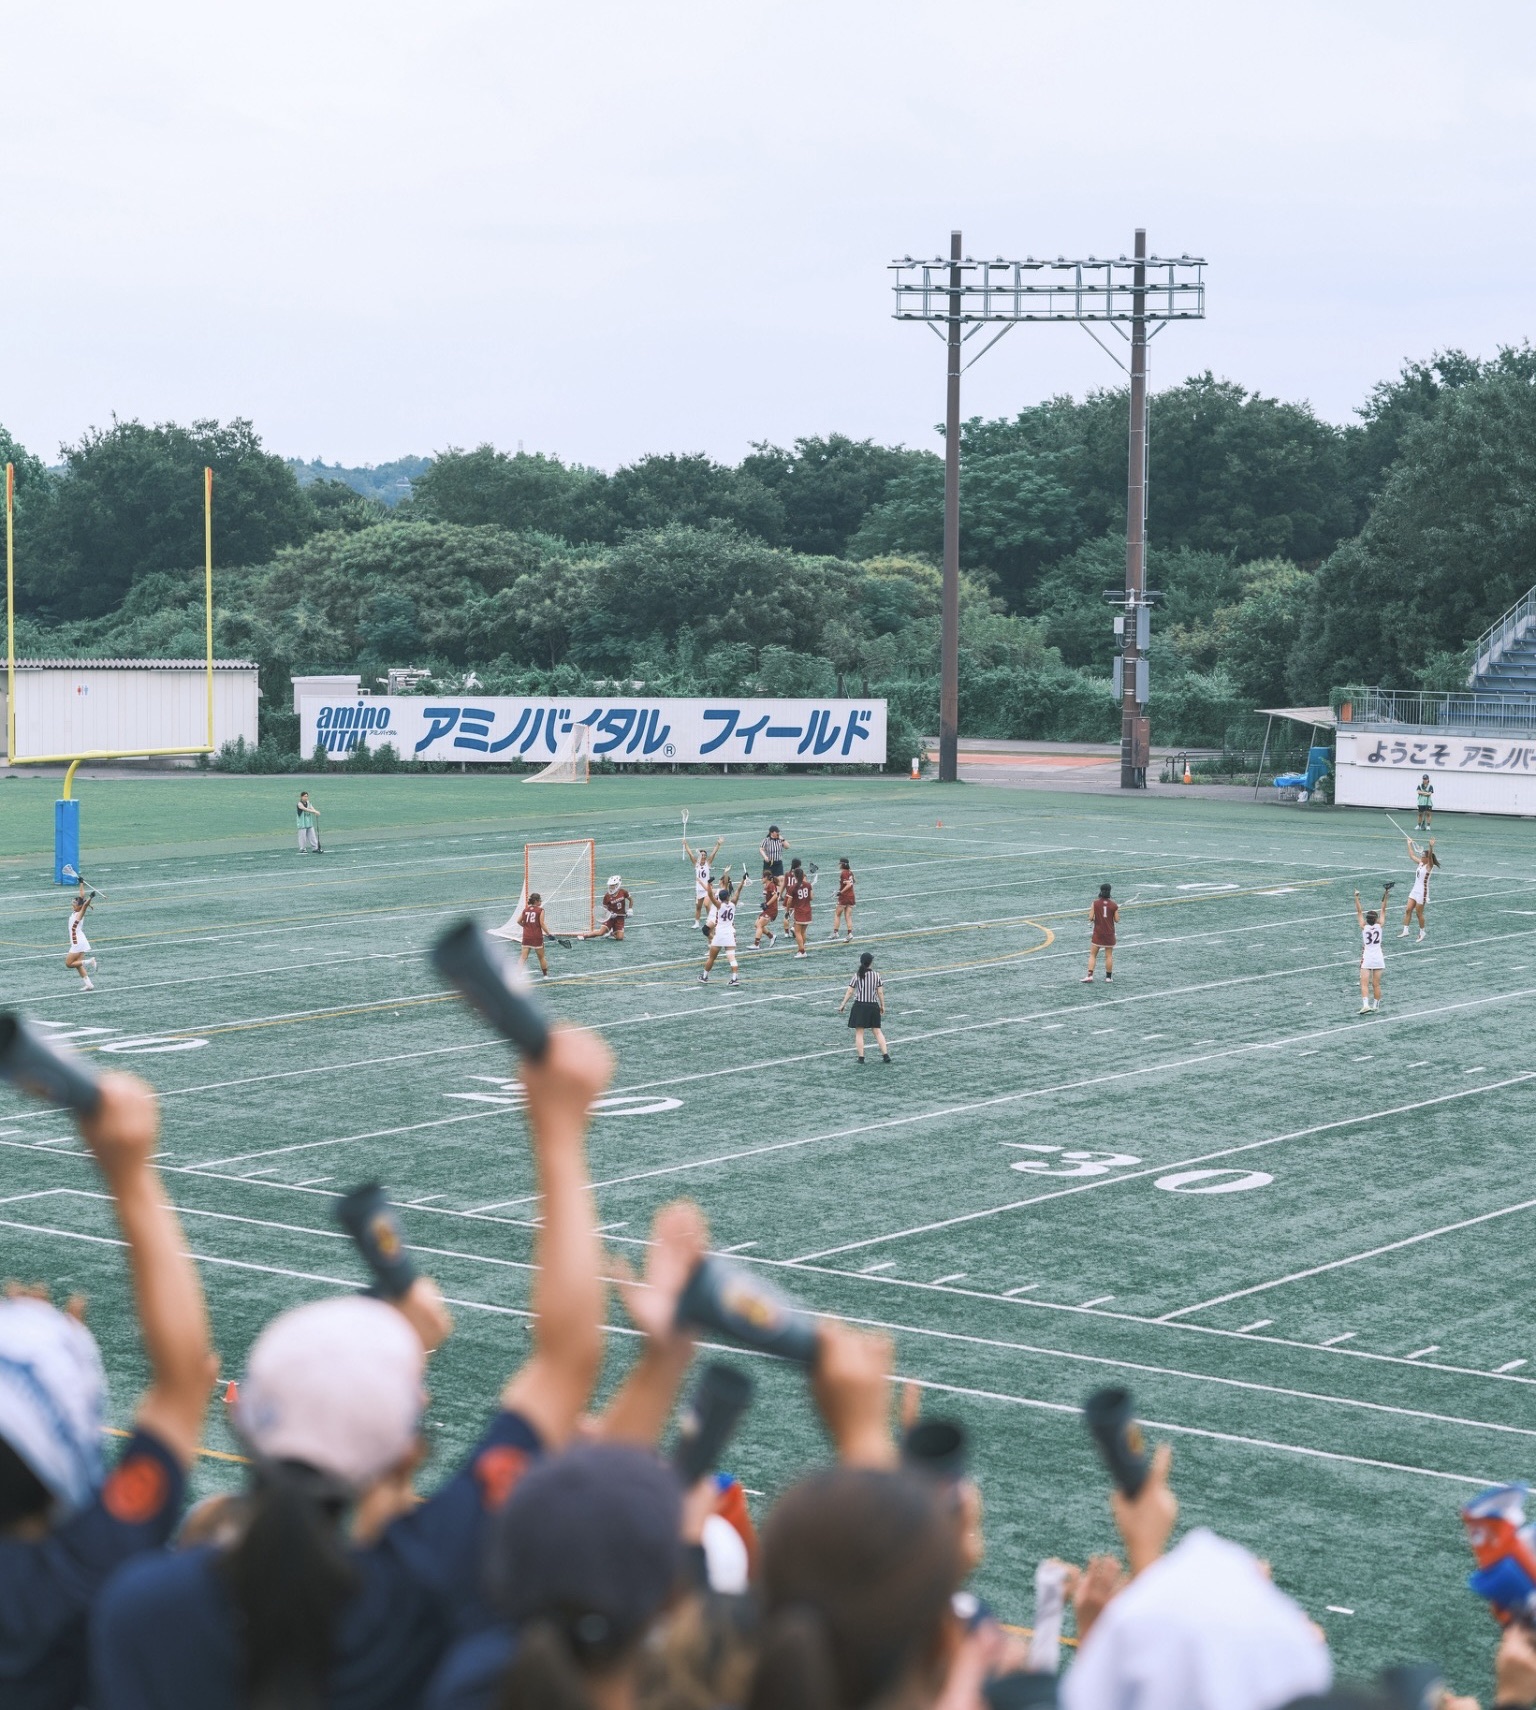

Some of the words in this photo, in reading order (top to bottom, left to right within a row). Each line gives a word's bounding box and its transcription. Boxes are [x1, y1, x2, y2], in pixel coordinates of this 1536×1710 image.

[316, 700, 391, 729] amino
[699, 709, 872, 756] フィールド
[1367, 740, 1450, 767] ようこそ
[1458, 746, 1536, 770] アミノバ
[797, 887, 809, 900] 98
[525, 911, 536, 923] 72
[720, 908, 734, 922] 46
[1102, 905, 1108, 918] 1
[1365, 930, 1380, 945] 32
[1009, 1151, 1275, 1194] 30
